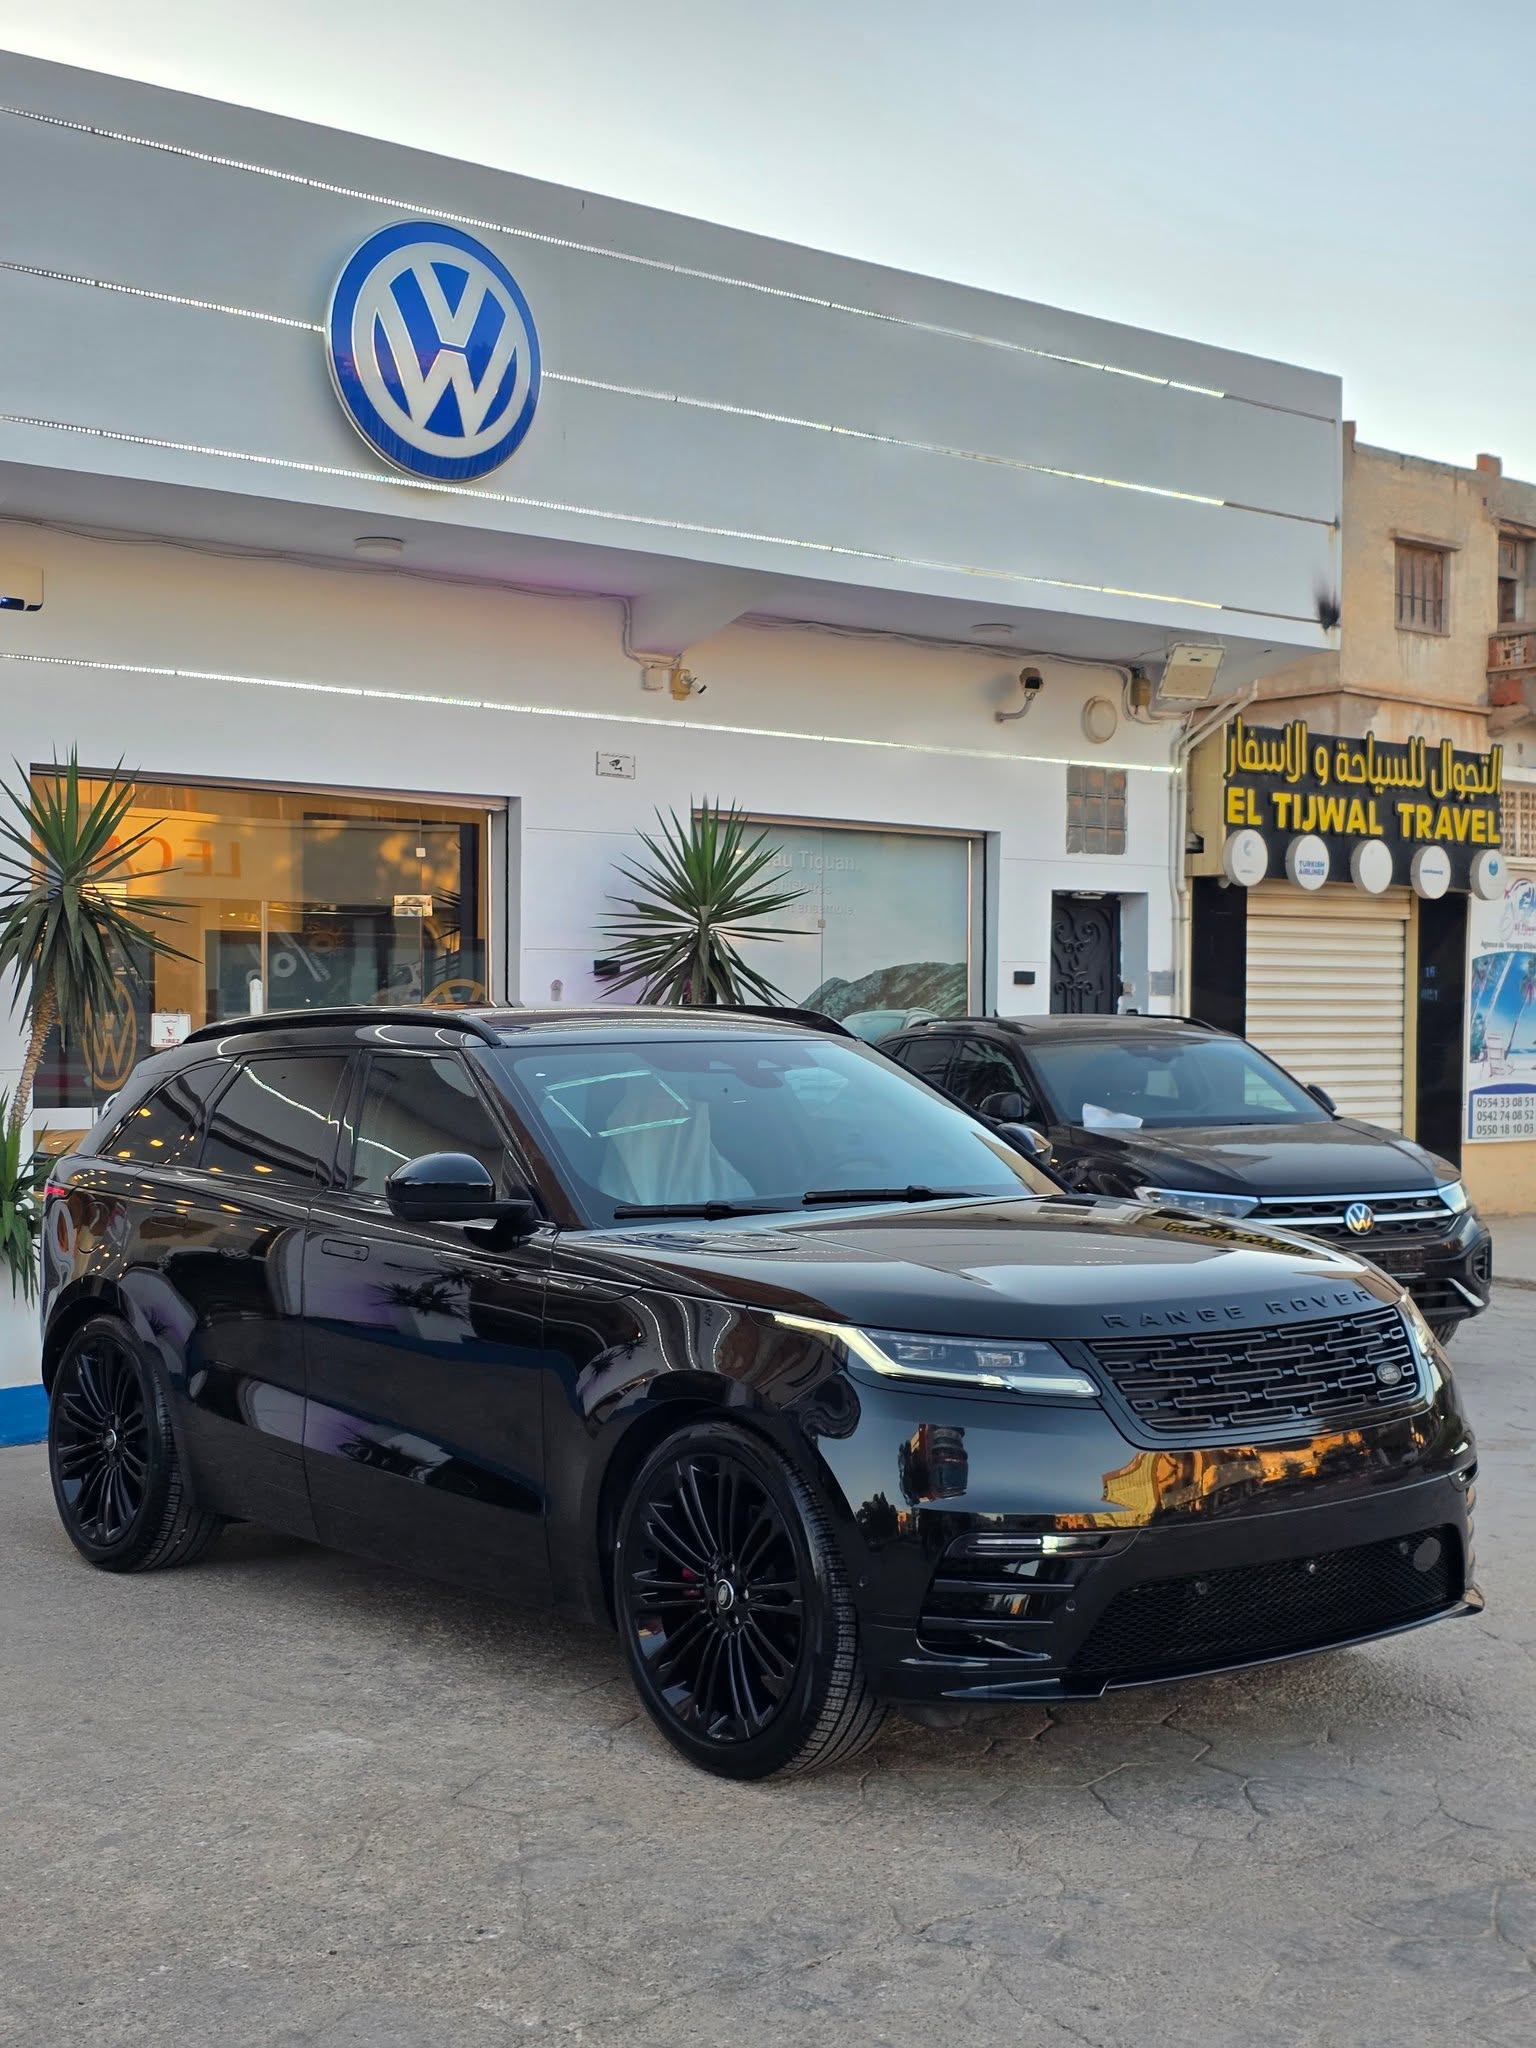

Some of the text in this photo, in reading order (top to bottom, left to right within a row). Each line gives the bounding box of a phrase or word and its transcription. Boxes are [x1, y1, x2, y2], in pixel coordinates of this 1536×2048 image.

[1315, 745, 1329, 786] و
[1336, 733, 1425, 794] للسياحة
[1431, 739, 1503, 802] التجوال
[1228, 786, 1501, 844] EL TIJWAL TRAVEL
[1476, 1096, 1534, 1108] 0554 33 08 51
[1476, 1109, 1534, 1121] 0542 74 08 52
[1476, 1123, 1534, 1135] 0550 18 10 03
[1102, 1289, 1376, 1329] RANGE ROVER
